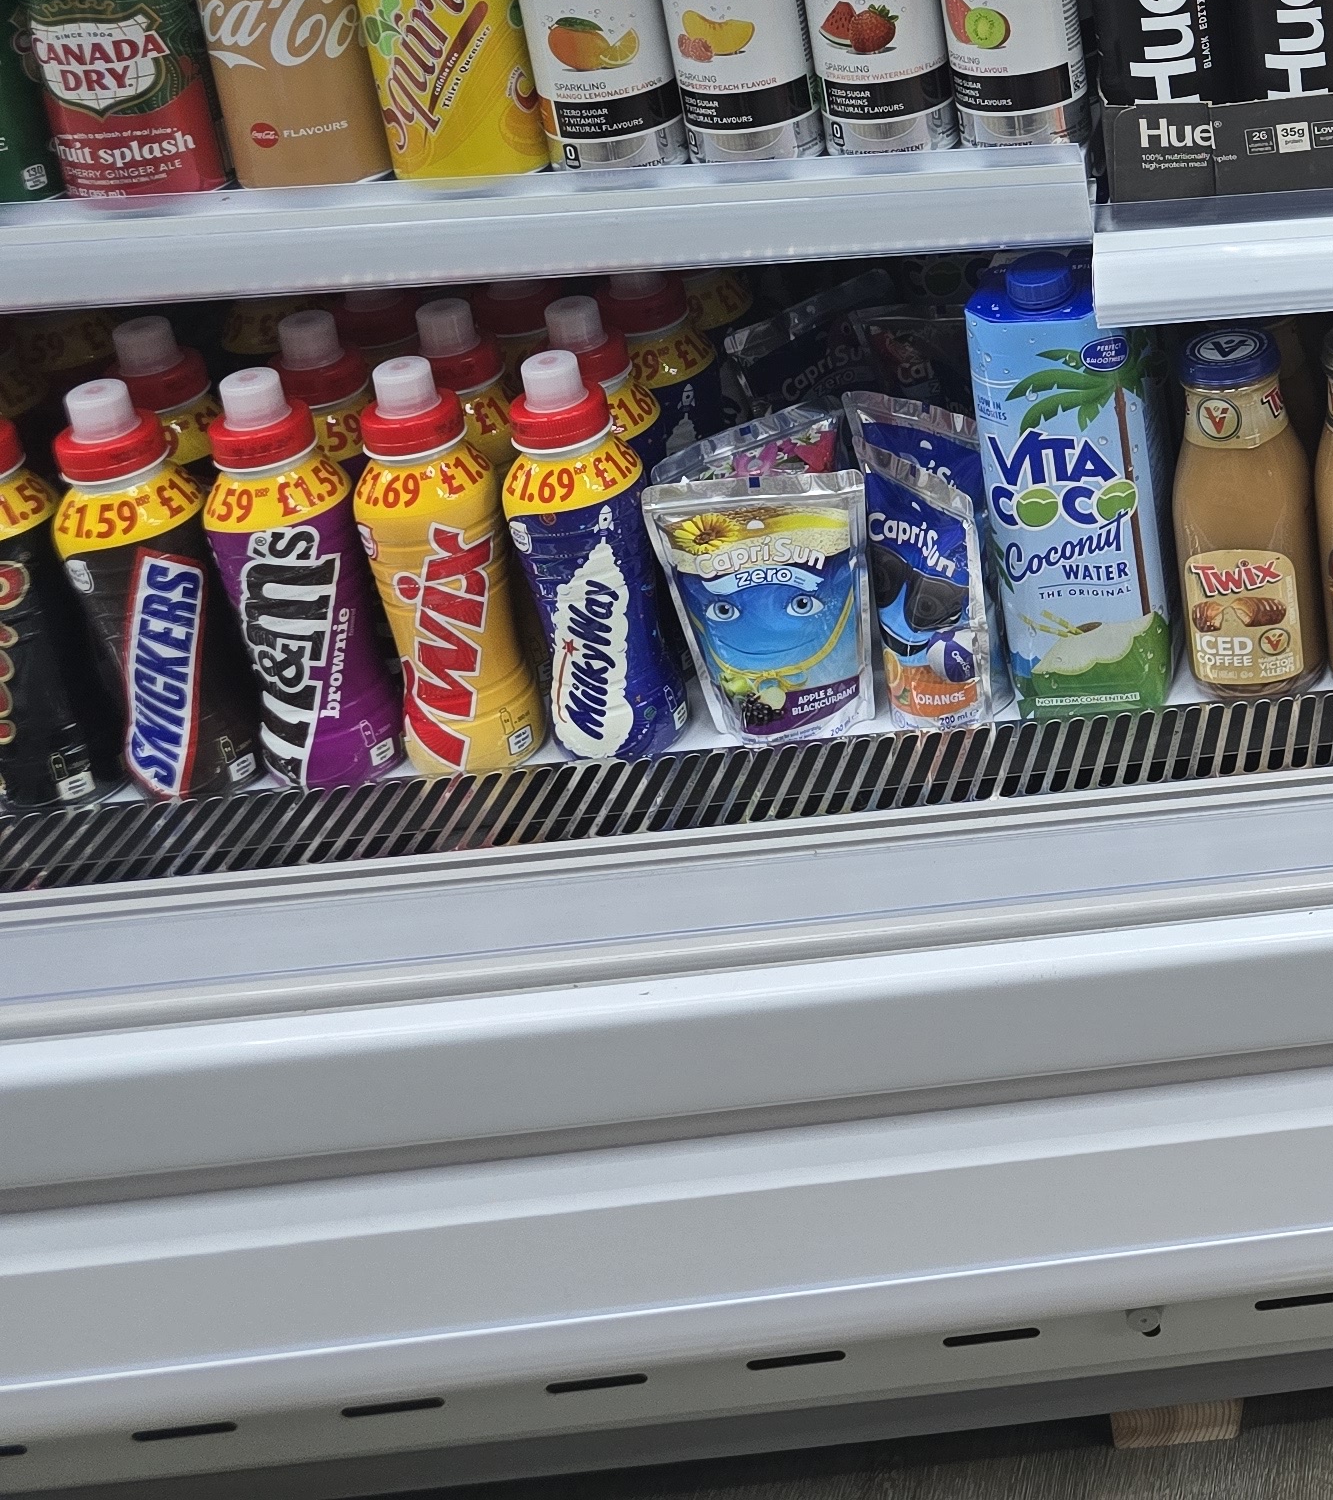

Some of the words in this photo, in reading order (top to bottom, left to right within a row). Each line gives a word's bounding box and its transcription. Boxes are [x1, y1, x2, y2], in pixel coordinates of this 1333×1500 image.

[33, 35, 168, 66] CANADA
[442, 79, 462, 108] Thirst
[456, 24, 492, 80] Quencher
[555, 81, 606, 93] SPARKLING
[283, 121, 348, 137] FLAVOURS
[98, 134, 195, 163] splash
[988, 434, 1117, 485] VITA
[992, 481, 1137, 529] COCO
[1006, 511, 1128, 581] Coconut
[736, 566, 791, 589] zero
[1063, 563, 1129, 580] WATER
[1039, 589, 1063, 598] THE
[1069, 585, 1132, 597] ORIGINAL
[131, 562, 202, 791] SNICKERS
[320, 608, 350, 719] brownie
[792, 684, 857, 715] BLACKCURRANT
[917, 690, 966, 706] ORANGE
